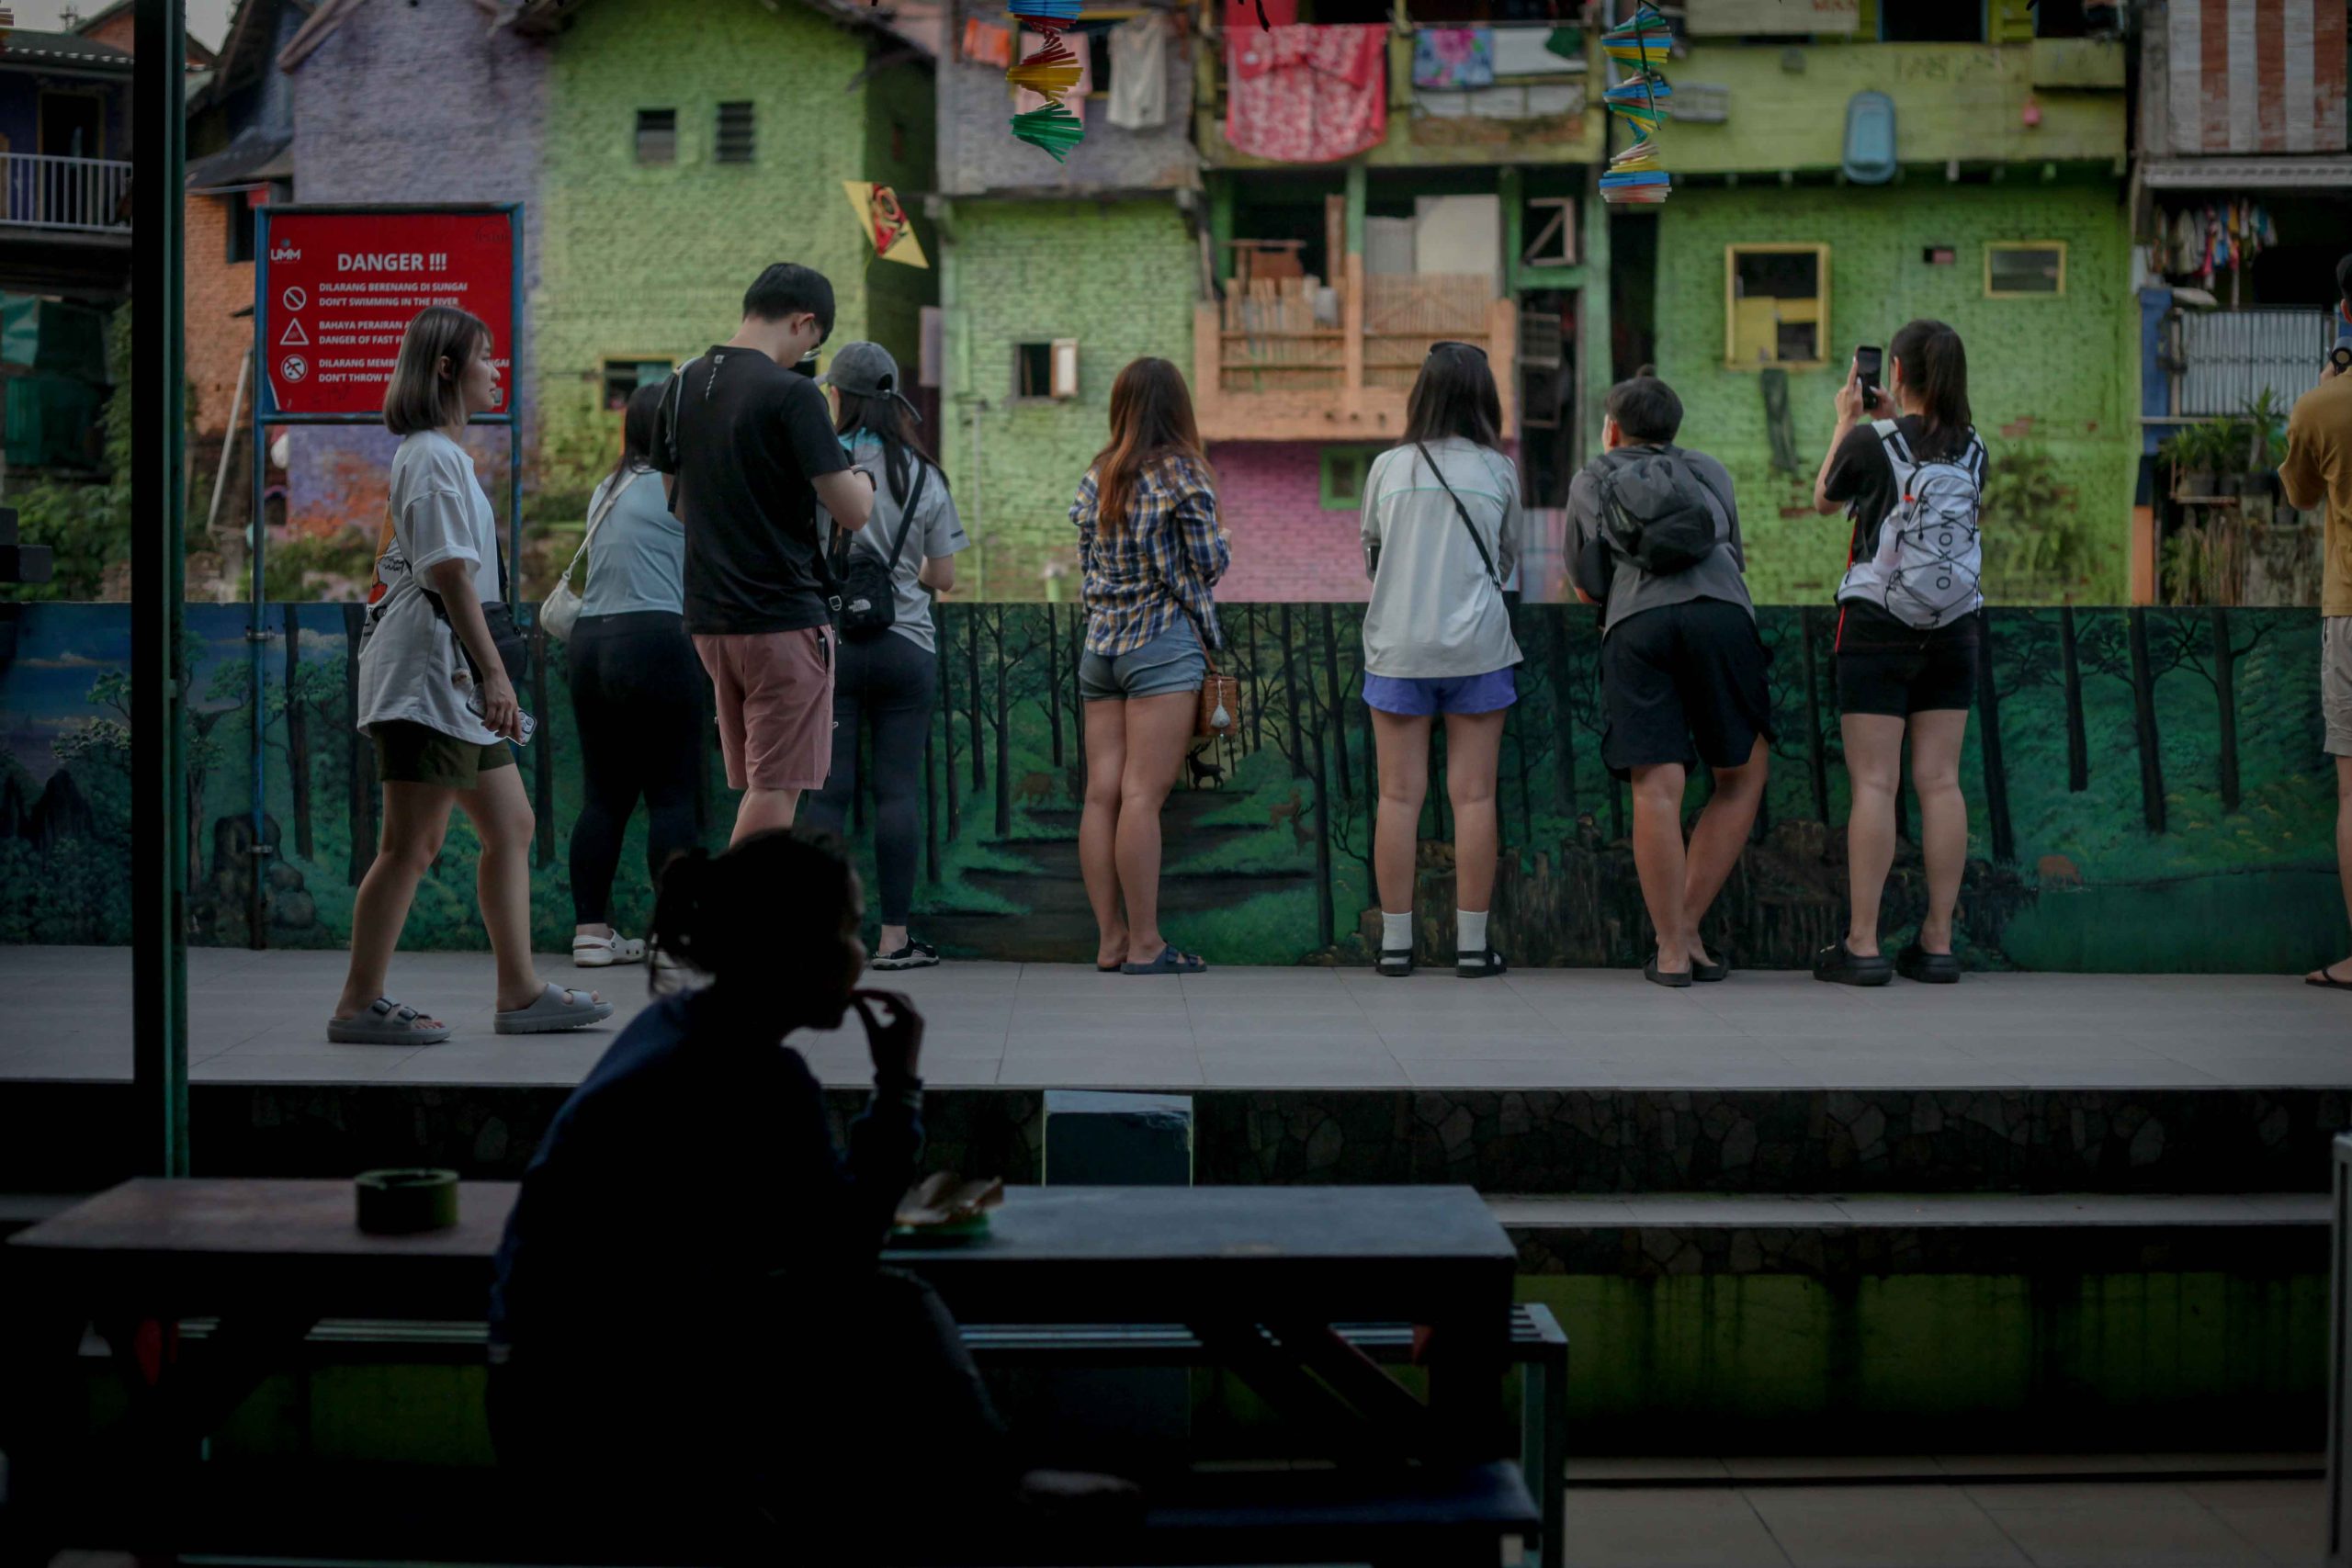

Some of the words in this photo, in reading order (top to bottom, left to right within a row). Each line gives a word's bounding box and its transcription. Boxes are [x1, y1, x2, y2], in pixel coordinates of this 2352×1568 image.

[337, 253, 424, 272] DANGER
[429, 253, 447, 272] !!!
[319, 282, 367, 292] DILARANG
[368, 282, 419, 292] BERENANG
[420, 282, 431, 292] DI
[432, 282, 469, 292] SUNGAI
[319, 298, 347, 307] DON'T
[349, 298, 400, 307] SWIMMING
[401, 298, 412, 307] IN
[413, 298, 431, 307] THE
[432, 297, 458, 307] RIVER
[319, 321, 356, 330] BAHAYA
[357, 321, 403, 330] PERAIRAN
[319, 335, 356, 344] DANGER
[357, 335, 370, 344] OF
[372, 335, 394, 344] FAST
[318, 358, 366, 367] DILARANG
[318, 373, 346, 382] DON'T
[348, 373, 383, 382] THROW
